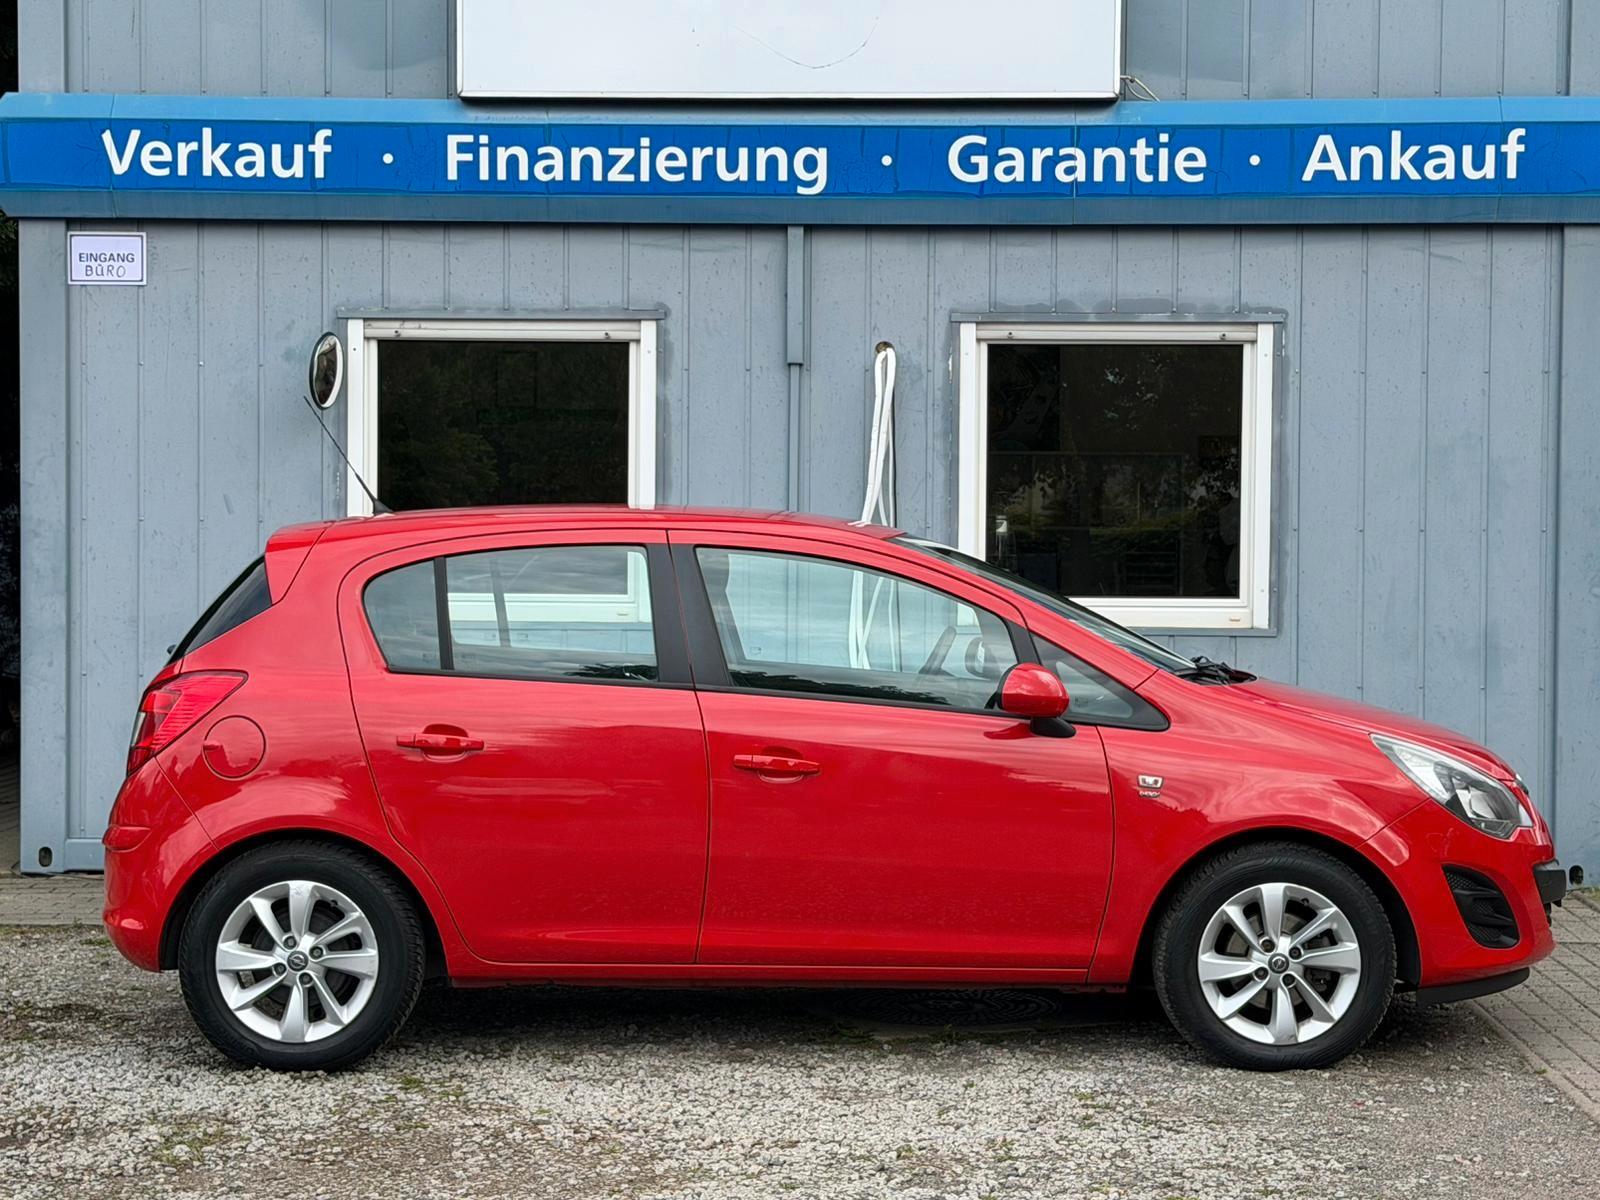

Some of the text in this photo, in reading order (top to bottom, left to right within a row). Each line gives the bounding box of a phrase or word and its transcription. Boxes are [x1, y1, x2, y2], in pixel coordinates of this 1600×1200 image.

[102, 128, 1526, 195] Verkauf Finanzierung Garantie Ankauf
[79, 253, 135, 263] EINGANG
